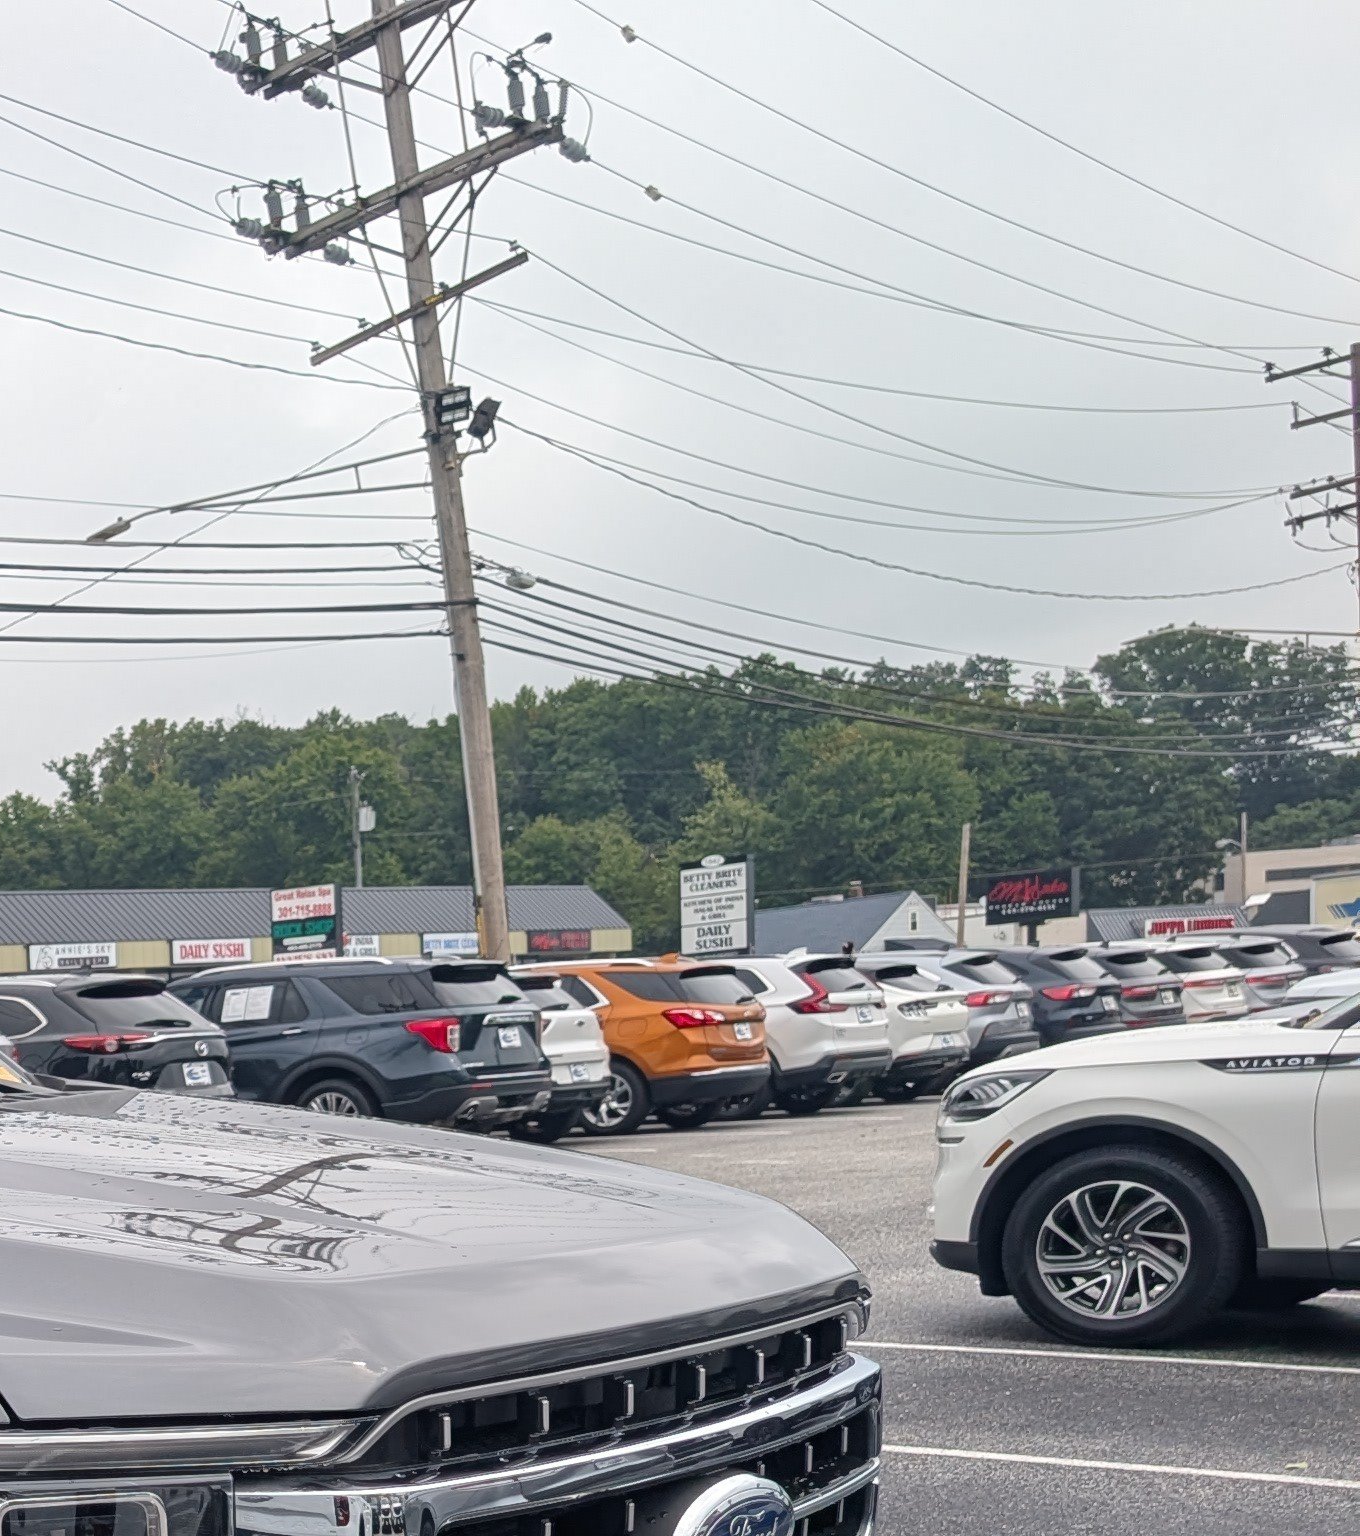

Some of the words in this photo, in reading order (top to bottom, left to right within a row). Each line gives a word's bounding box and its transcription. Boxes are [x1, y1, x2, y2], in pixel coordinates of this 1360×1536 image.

[689, 880, 737, 892] CLEANERS
[696, 923, 731, 938] DAILY
[696, 937, 733, 950] SUSHI
[179, 943, 209, 960] DAILY
[212, 942, 245, 959] SUSHI
[1226, 1056, 1316, 1069] AVIATOR
